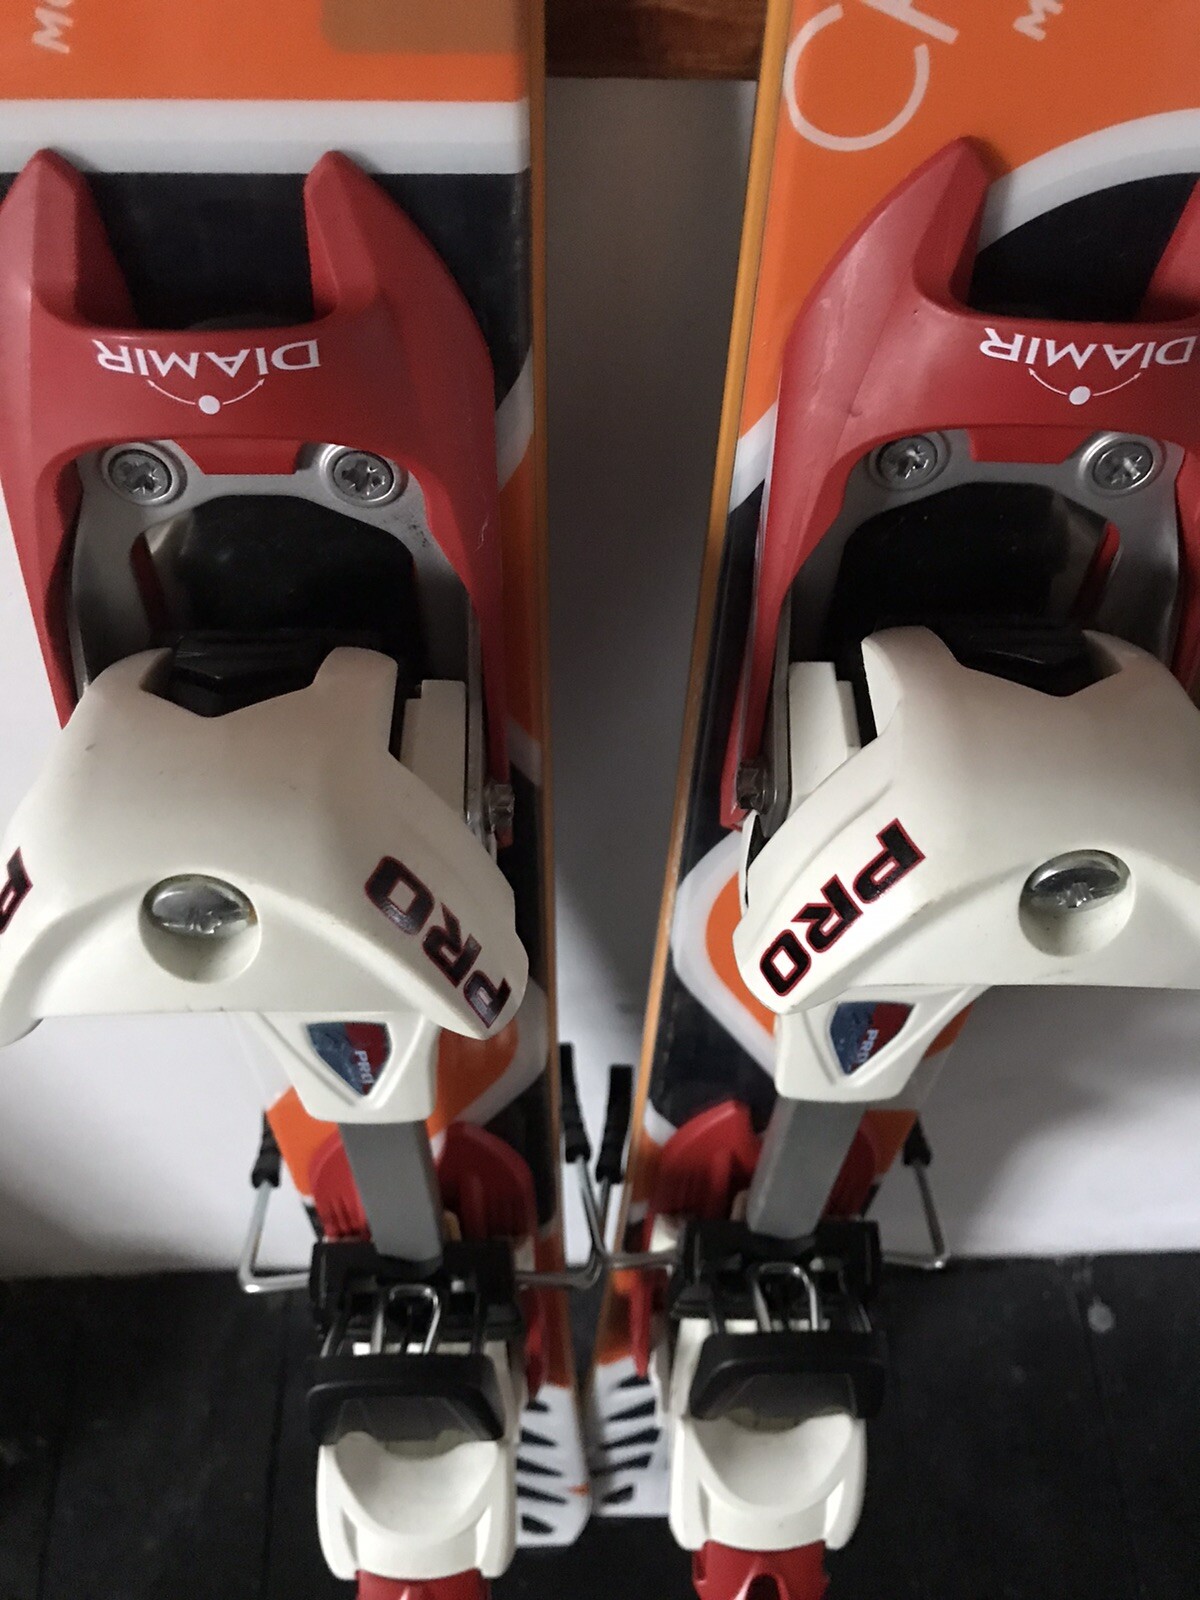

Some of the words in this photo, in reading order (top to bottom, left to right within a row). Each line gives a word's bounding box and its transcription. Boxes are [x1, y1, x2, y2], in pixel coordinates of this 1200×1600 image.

[92, 338, 321, 379] DIAMIR
[980, 327, 1198, 370] DIAMIR
[365, 855, 512, 1029] PRO
[760, 818, 926, 996] PRO
